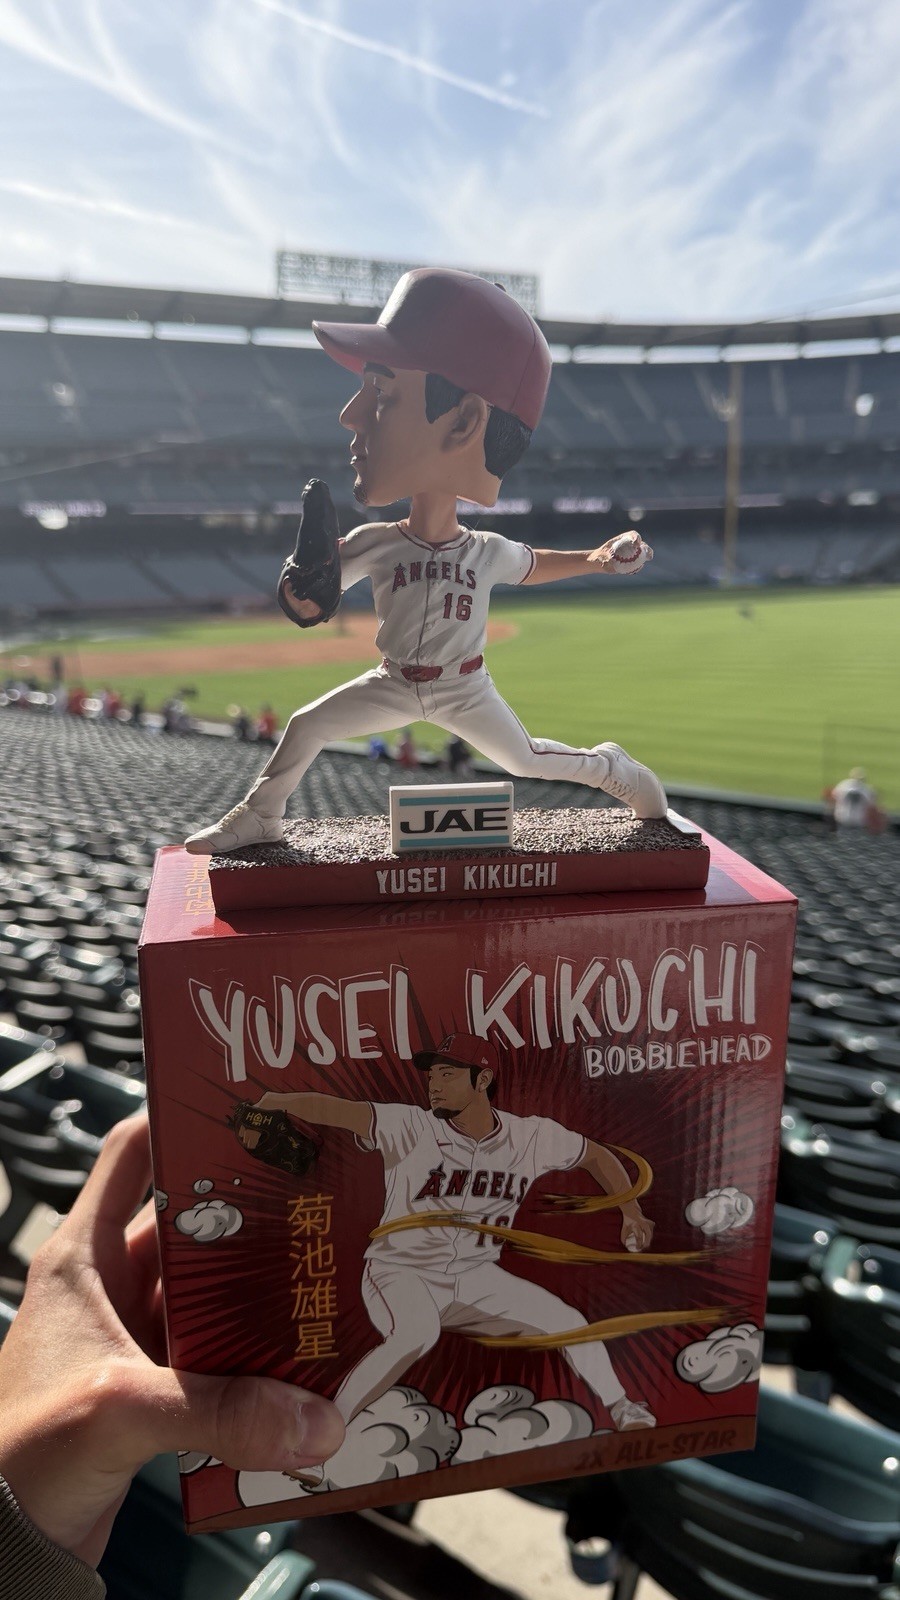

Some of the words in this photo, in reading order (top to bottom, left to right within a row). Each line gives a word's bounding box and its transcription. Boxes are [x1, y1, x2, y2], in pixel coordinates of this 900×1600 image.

[392, 561, 477, 594] ANGELS
[443, 593, 473, 621] 16
[400, 807, 510, 834] JAE
[376, 866, 446, 894] YUSEI
[464, 862, 557, 891] KIKUCHI
[189, 964, 413, 1083] YUSEI
[466, 940, 766, 1050] KIKUCHI
[583, 1033, 773, 1078] BOBBLEHEAD
[411, 1161, 529, 1205] ANGELS
[287, 1193, 340, 1361] 菊池雄星
[615, 1429, 738, 1464] ALL-STAR
